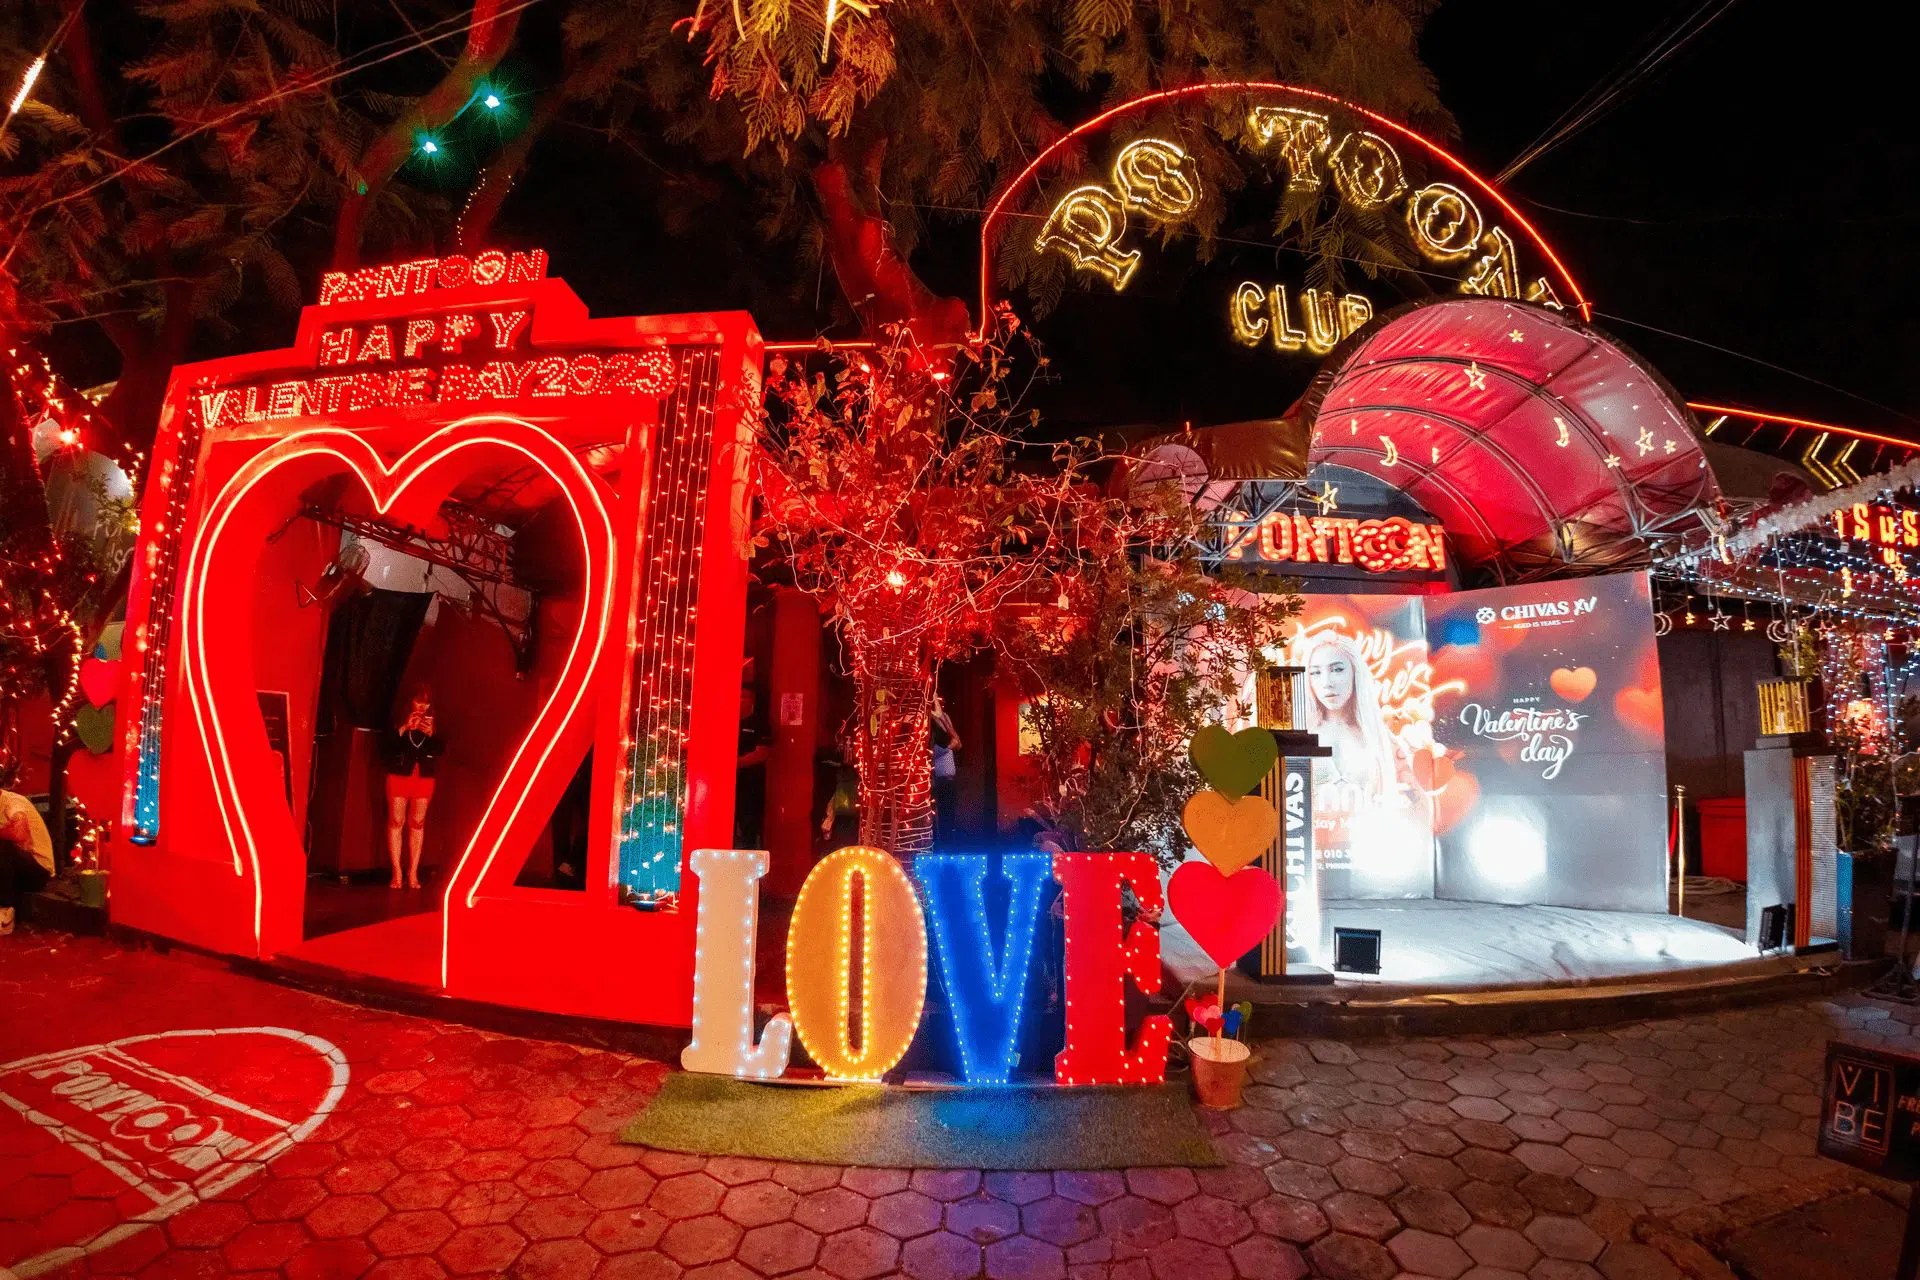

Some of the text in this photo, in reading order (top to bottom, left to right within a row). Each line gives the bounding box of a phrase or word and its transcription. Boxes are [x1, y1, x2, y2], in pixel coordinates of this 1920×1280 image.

[319, 310, 527, 366] HAPPY
[1500, 600, 1570, 621] CHIVAS
[1512, 622, 1532, 630] AGED
[1540, 619, 1562, 628] YEARS
[1512, 696, 1541, 704] HAPPY
[1459, 703, 1590, 741] Valentine's
[1520, 732, 1574, 780] day
[680, 844, 1174, 1086] LOVE
